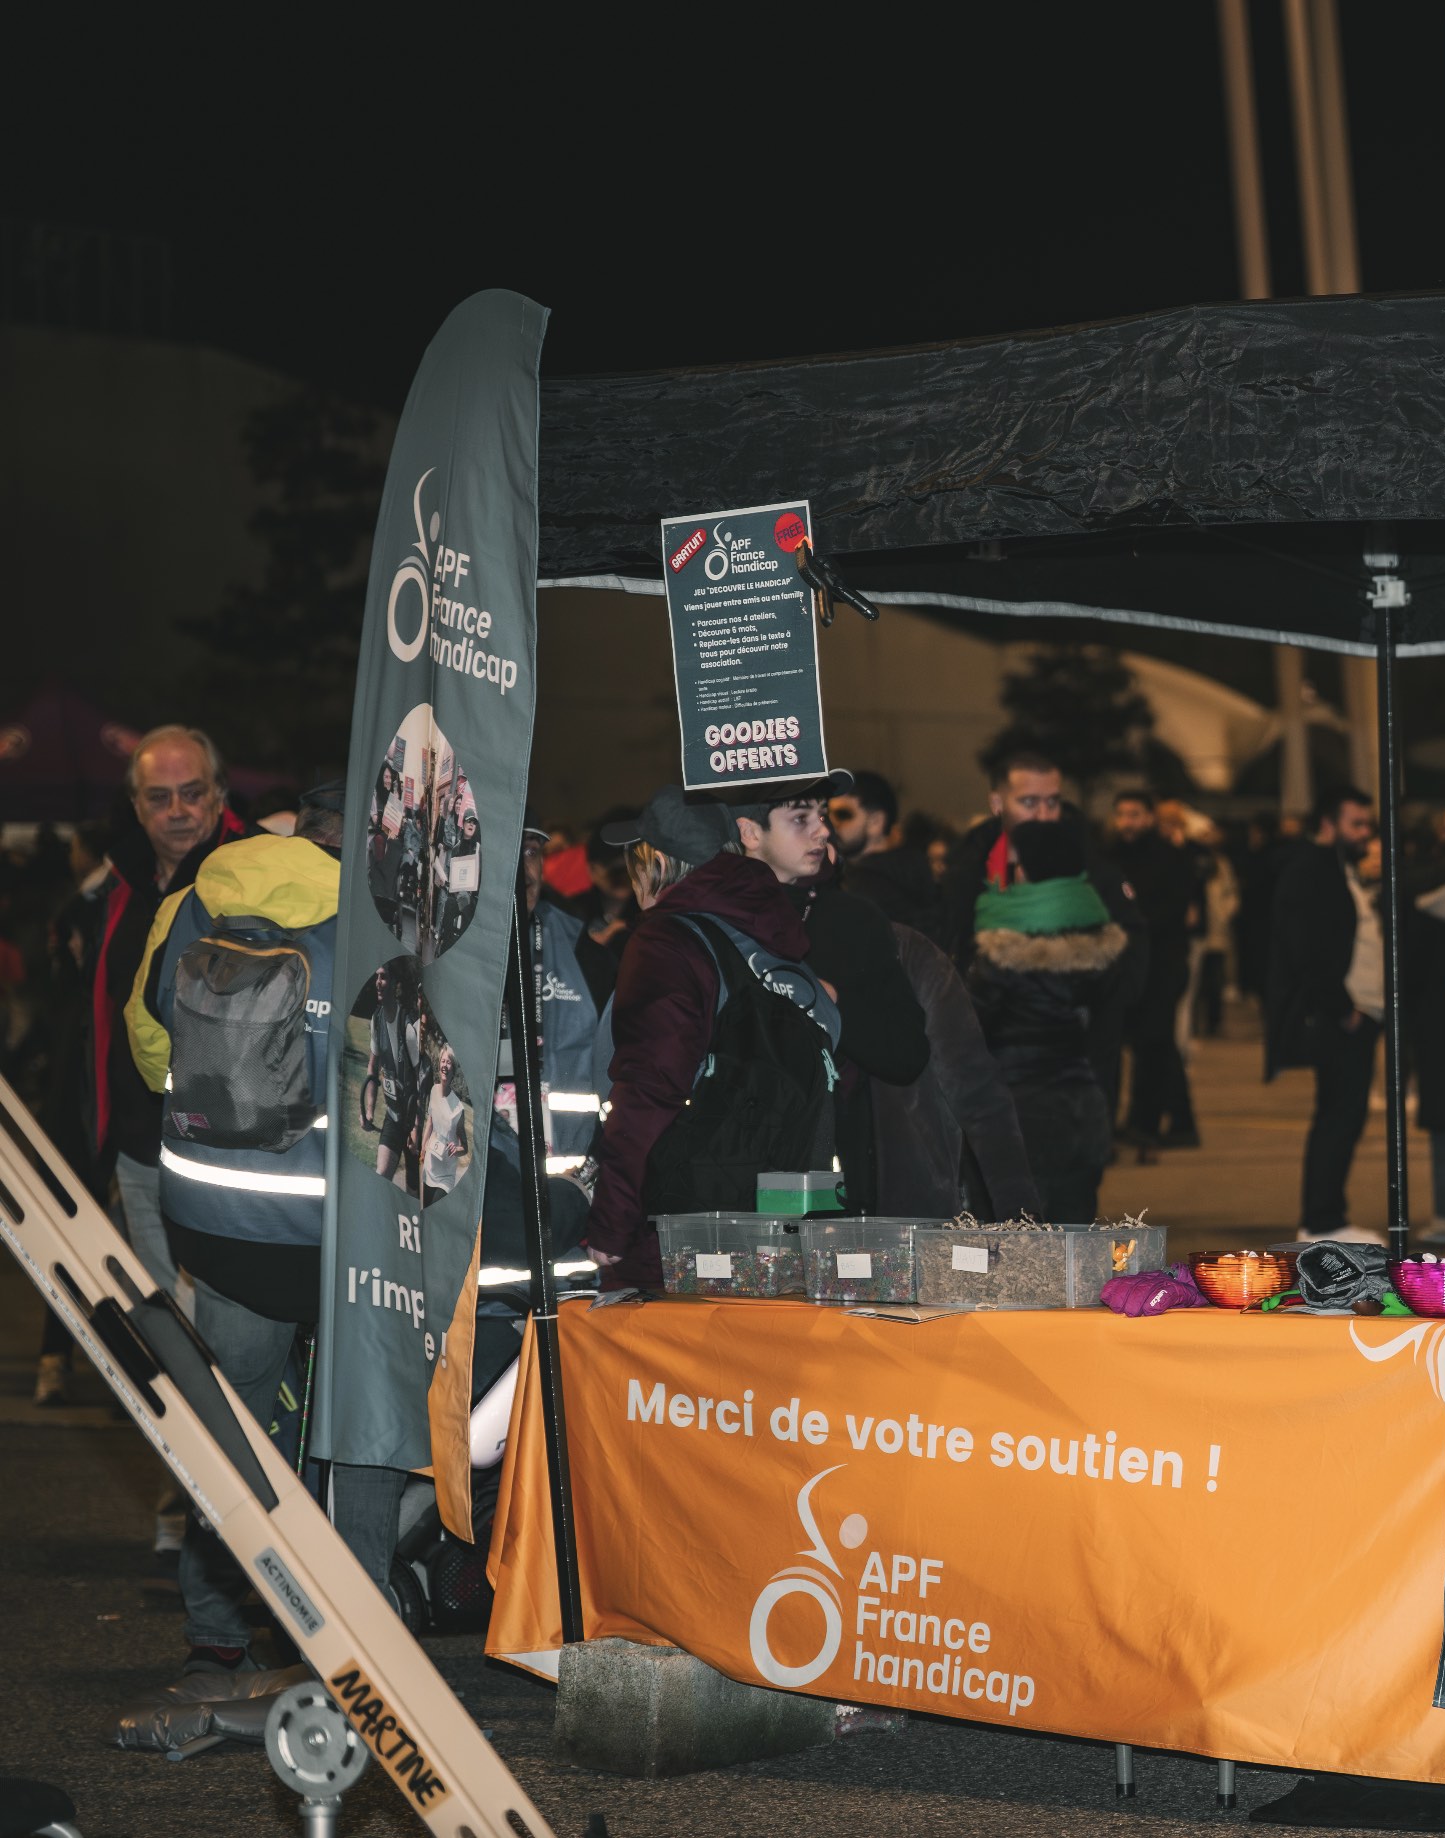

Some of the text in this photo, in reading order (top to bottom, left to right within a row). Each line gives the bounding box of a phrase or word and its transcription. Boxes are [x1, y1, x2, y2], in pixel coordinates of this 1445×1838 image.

[671, 531, 704, 570] GRATUIT
[729, 538, 752, 553] APF
[776, 521, 803, 543] FREE
[433, 544, 471, 588] APF
[730, 550, 765, 563] France
[731, 560, 778, 574] handicap
[431, 582, 492, 639] Fance
[705, 716, 799, 746] GOODIES
[710, 744, 798, 772] OFFERTS
[772, 981, 795, 1000] APF
[628, 1380, 1222, 1493] Merci de votre soutien !
[859, 1551, 943, 1598] APF
[856, 1596, 990, 1657] France
[854, 1641, 1035, 1715] handicap
[331, 1669, 447, 1808] MARTINE
